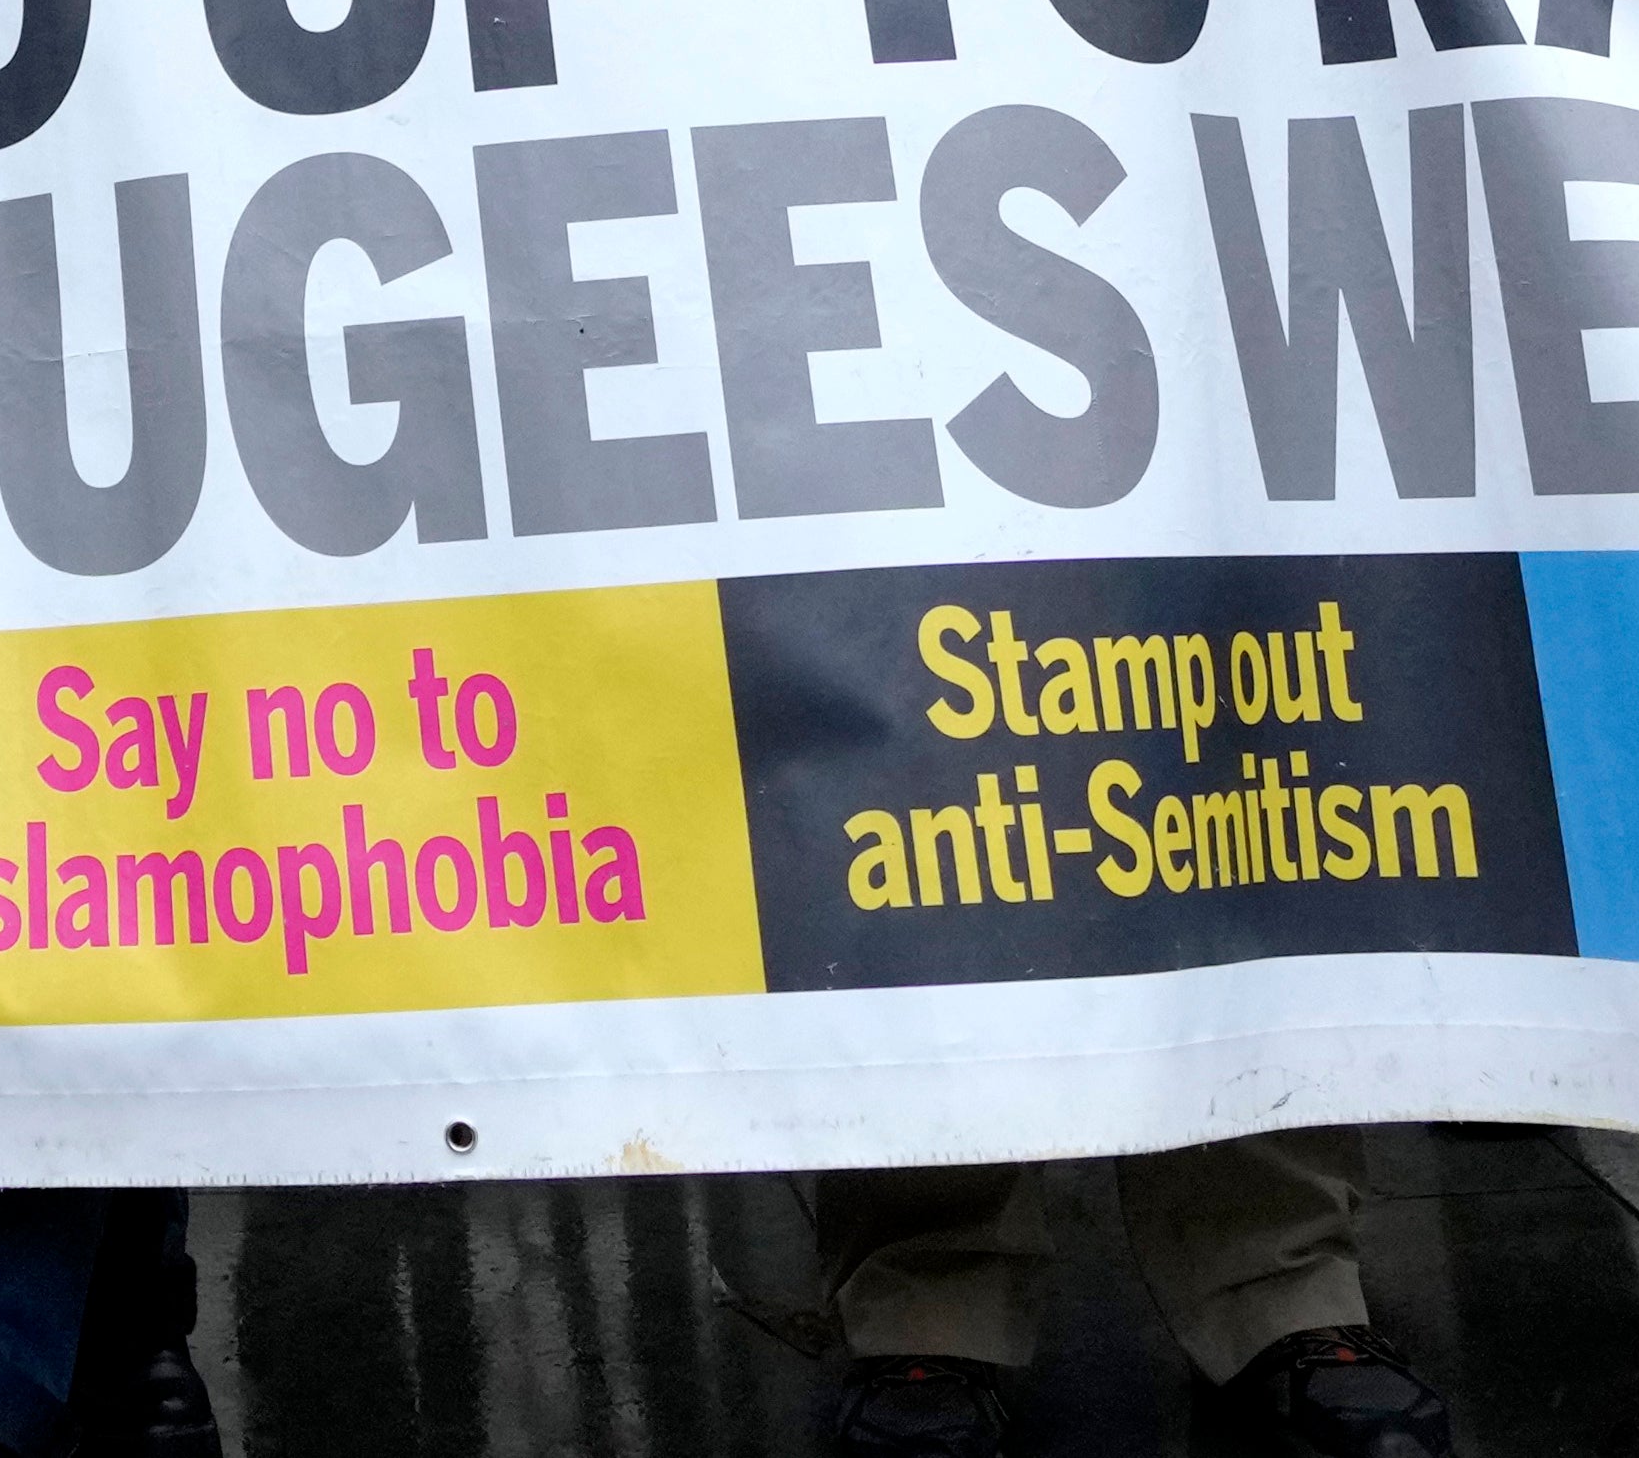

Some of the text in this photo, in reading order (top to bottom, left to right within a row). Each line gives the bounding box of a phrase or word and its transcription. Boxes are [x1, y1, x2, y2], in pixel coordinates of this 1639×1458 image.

[34, 648, 517, 825] Say no to
[918, 602, 1363, 762] Stamp out
[844, 751, 1478, 910] anti-Semitism
